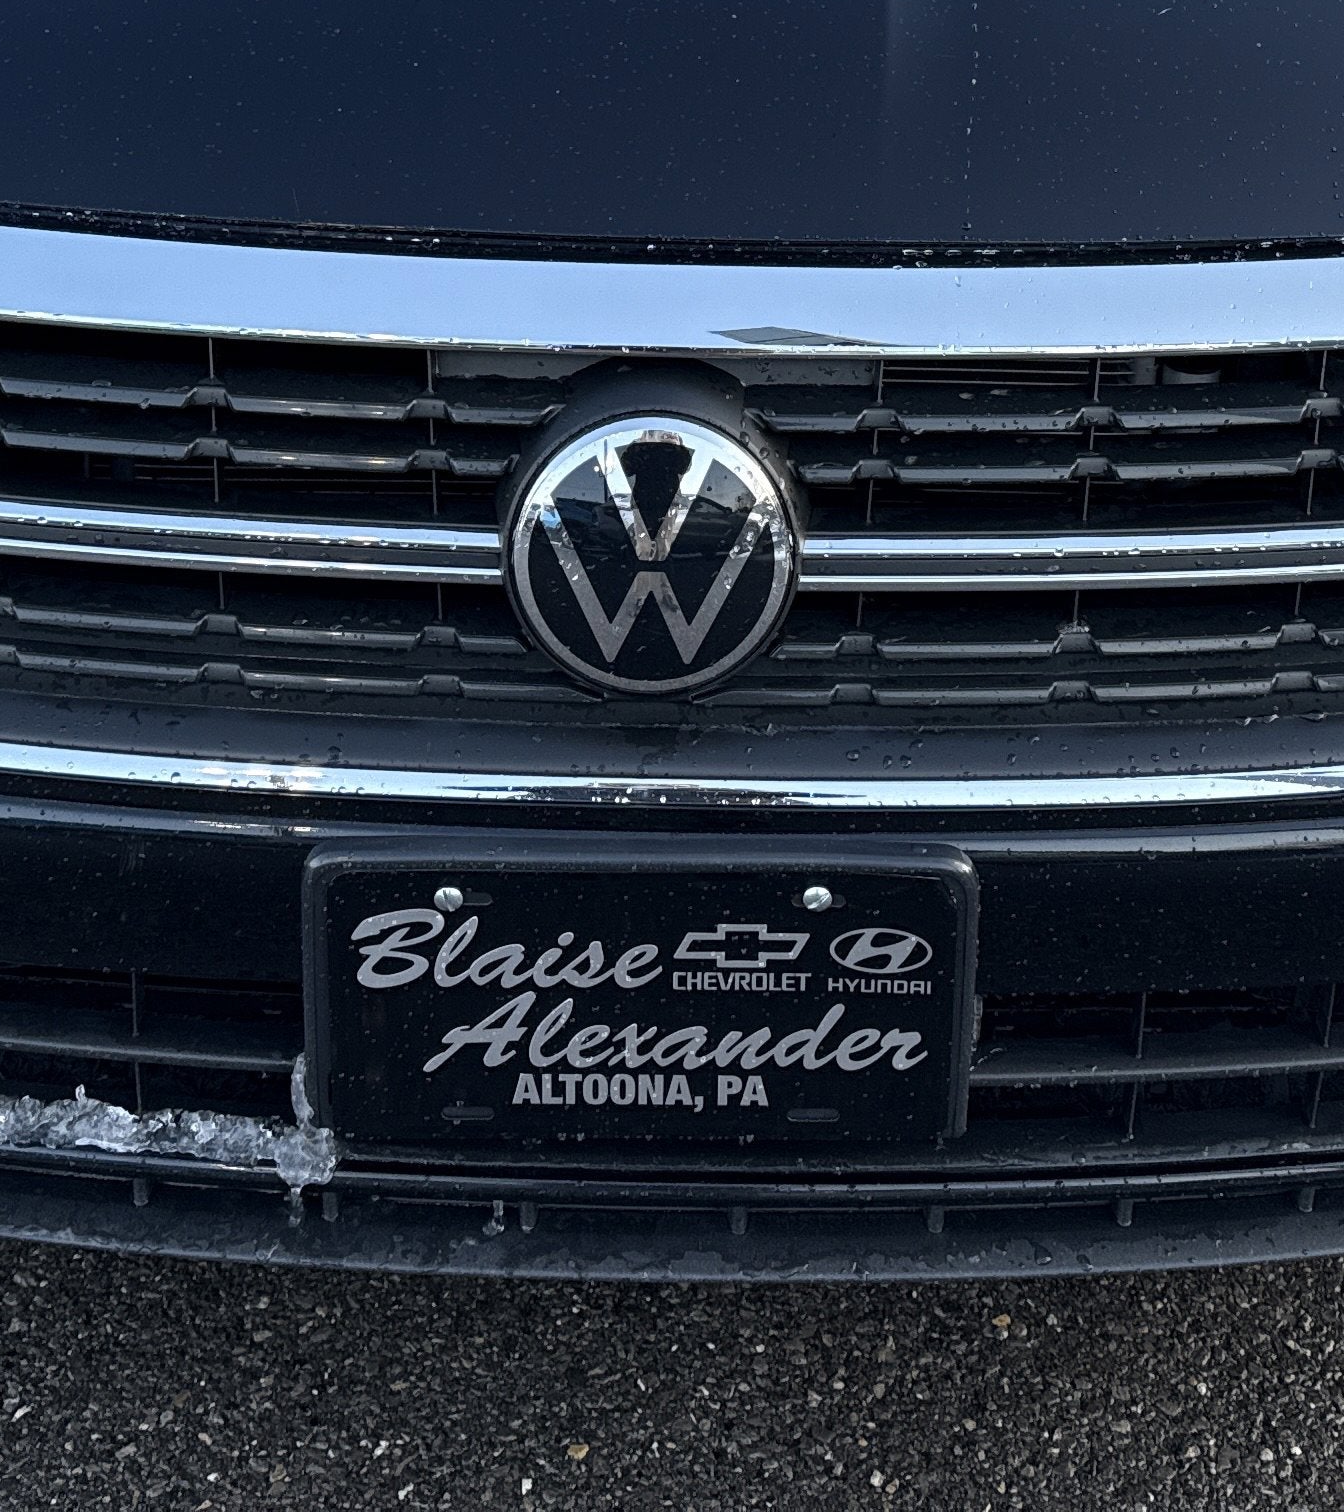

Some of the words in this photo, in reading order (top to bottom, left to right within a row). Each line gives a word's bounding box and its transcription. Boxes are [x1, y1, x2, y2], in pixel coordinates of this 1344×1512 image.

[351, 908, 663, 989] Blaise
[672, 971, 812, 992] CHEVROLET
[827, 977, 932, 996] HYUNDAI
[422, 990, 928, 1073] Alexander
[512, 1073, 705, 1113] ALTOONA,
[717, 1074, 769, 1107] PA
